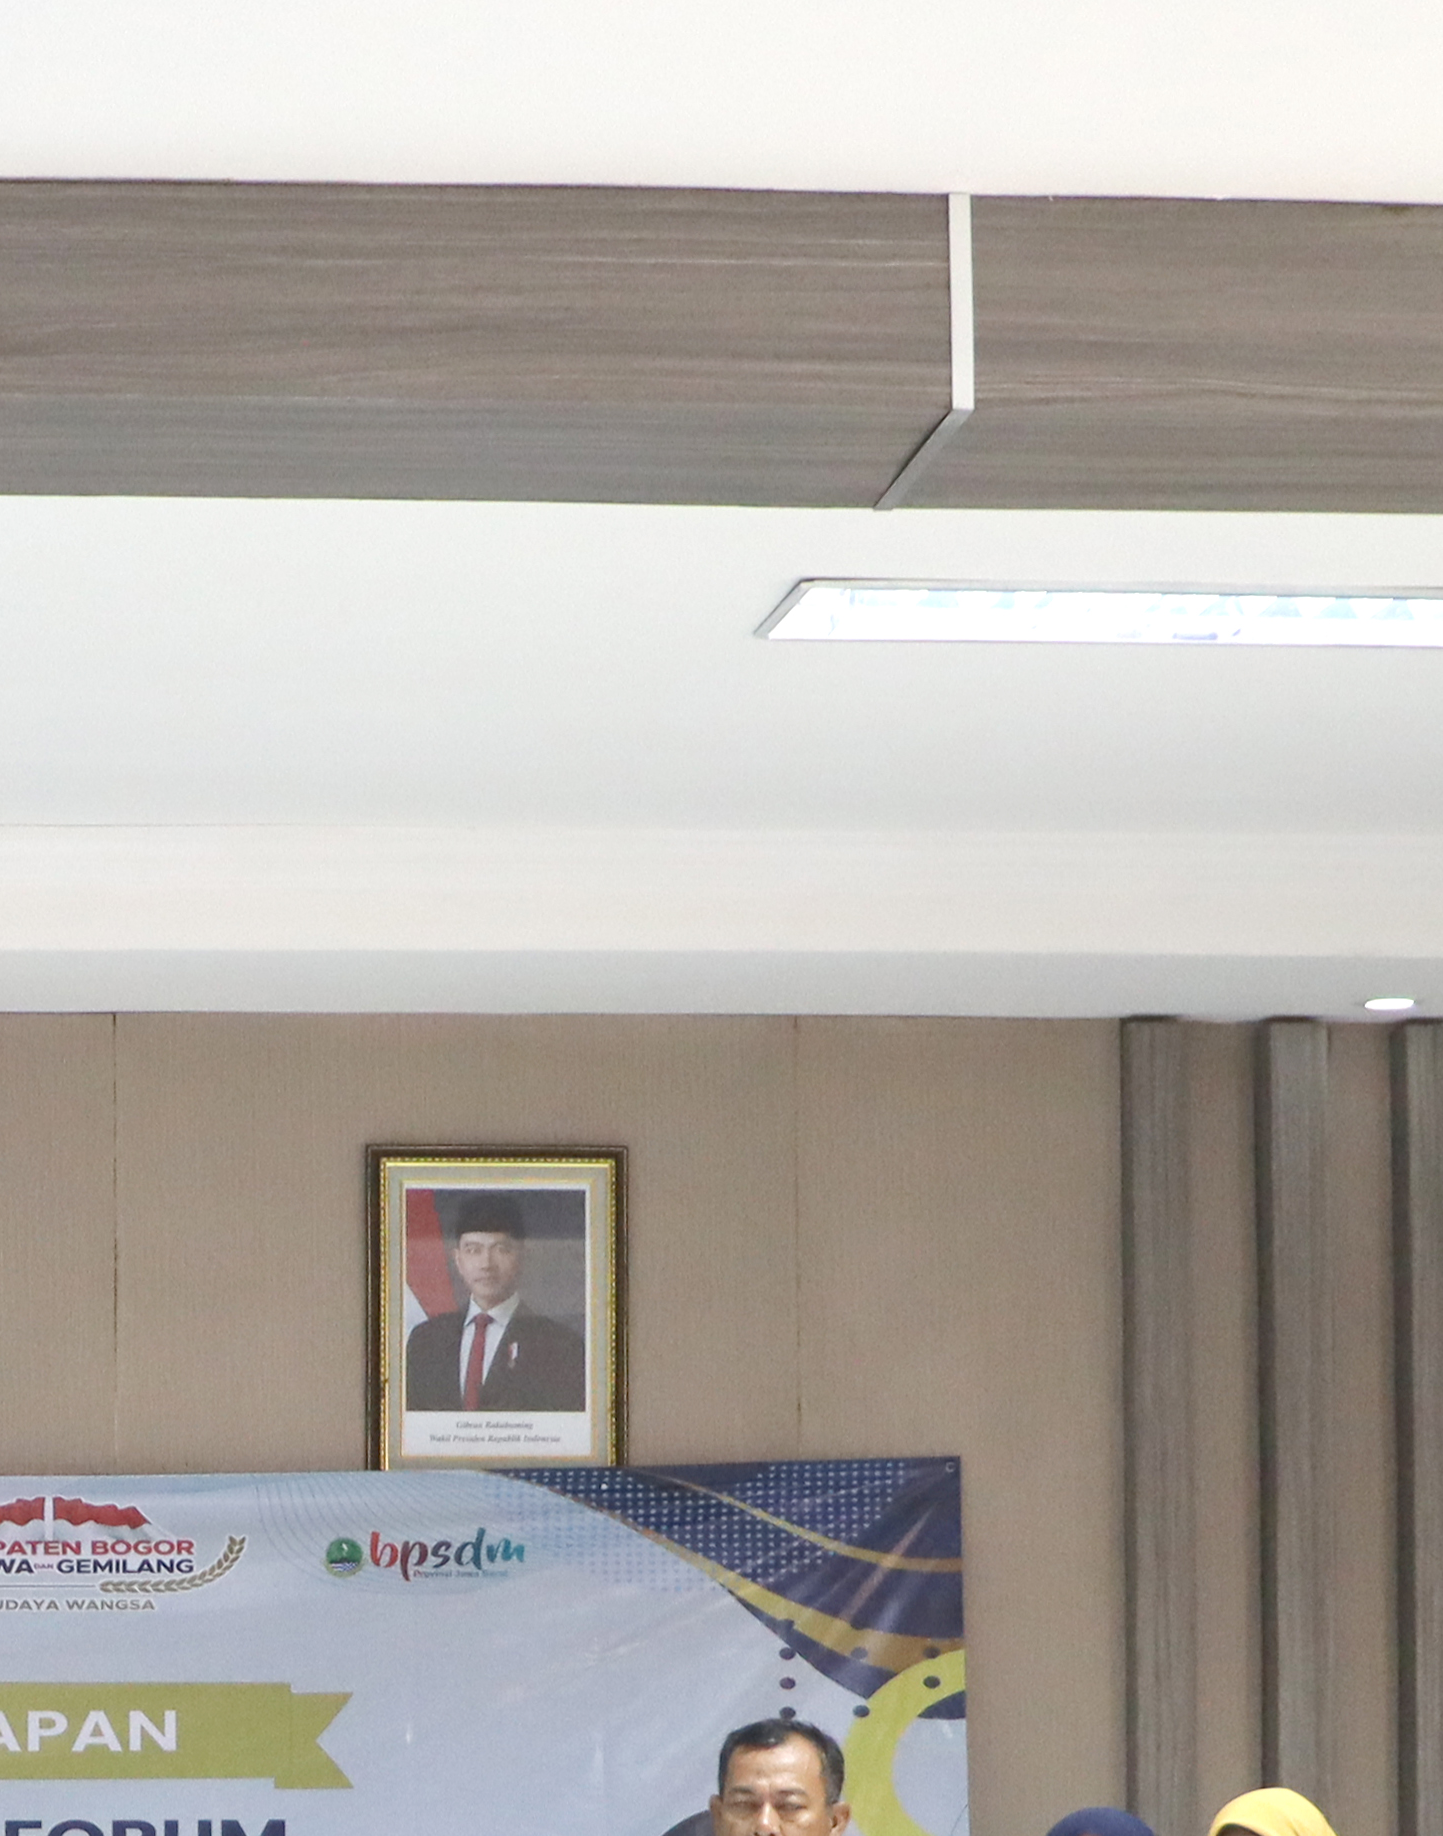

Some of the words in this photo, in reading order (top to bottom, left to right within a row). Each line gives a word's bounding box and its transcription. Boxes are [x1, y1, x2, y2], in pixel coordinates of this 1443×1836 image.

[90, 1540, 195, 1556] BOGOR
[369, 1527, 525, 1582] bpsdm
[56, 1558, 195, 1574] GEMILANG
[65, 1599, 155, 1611] WANGSA
